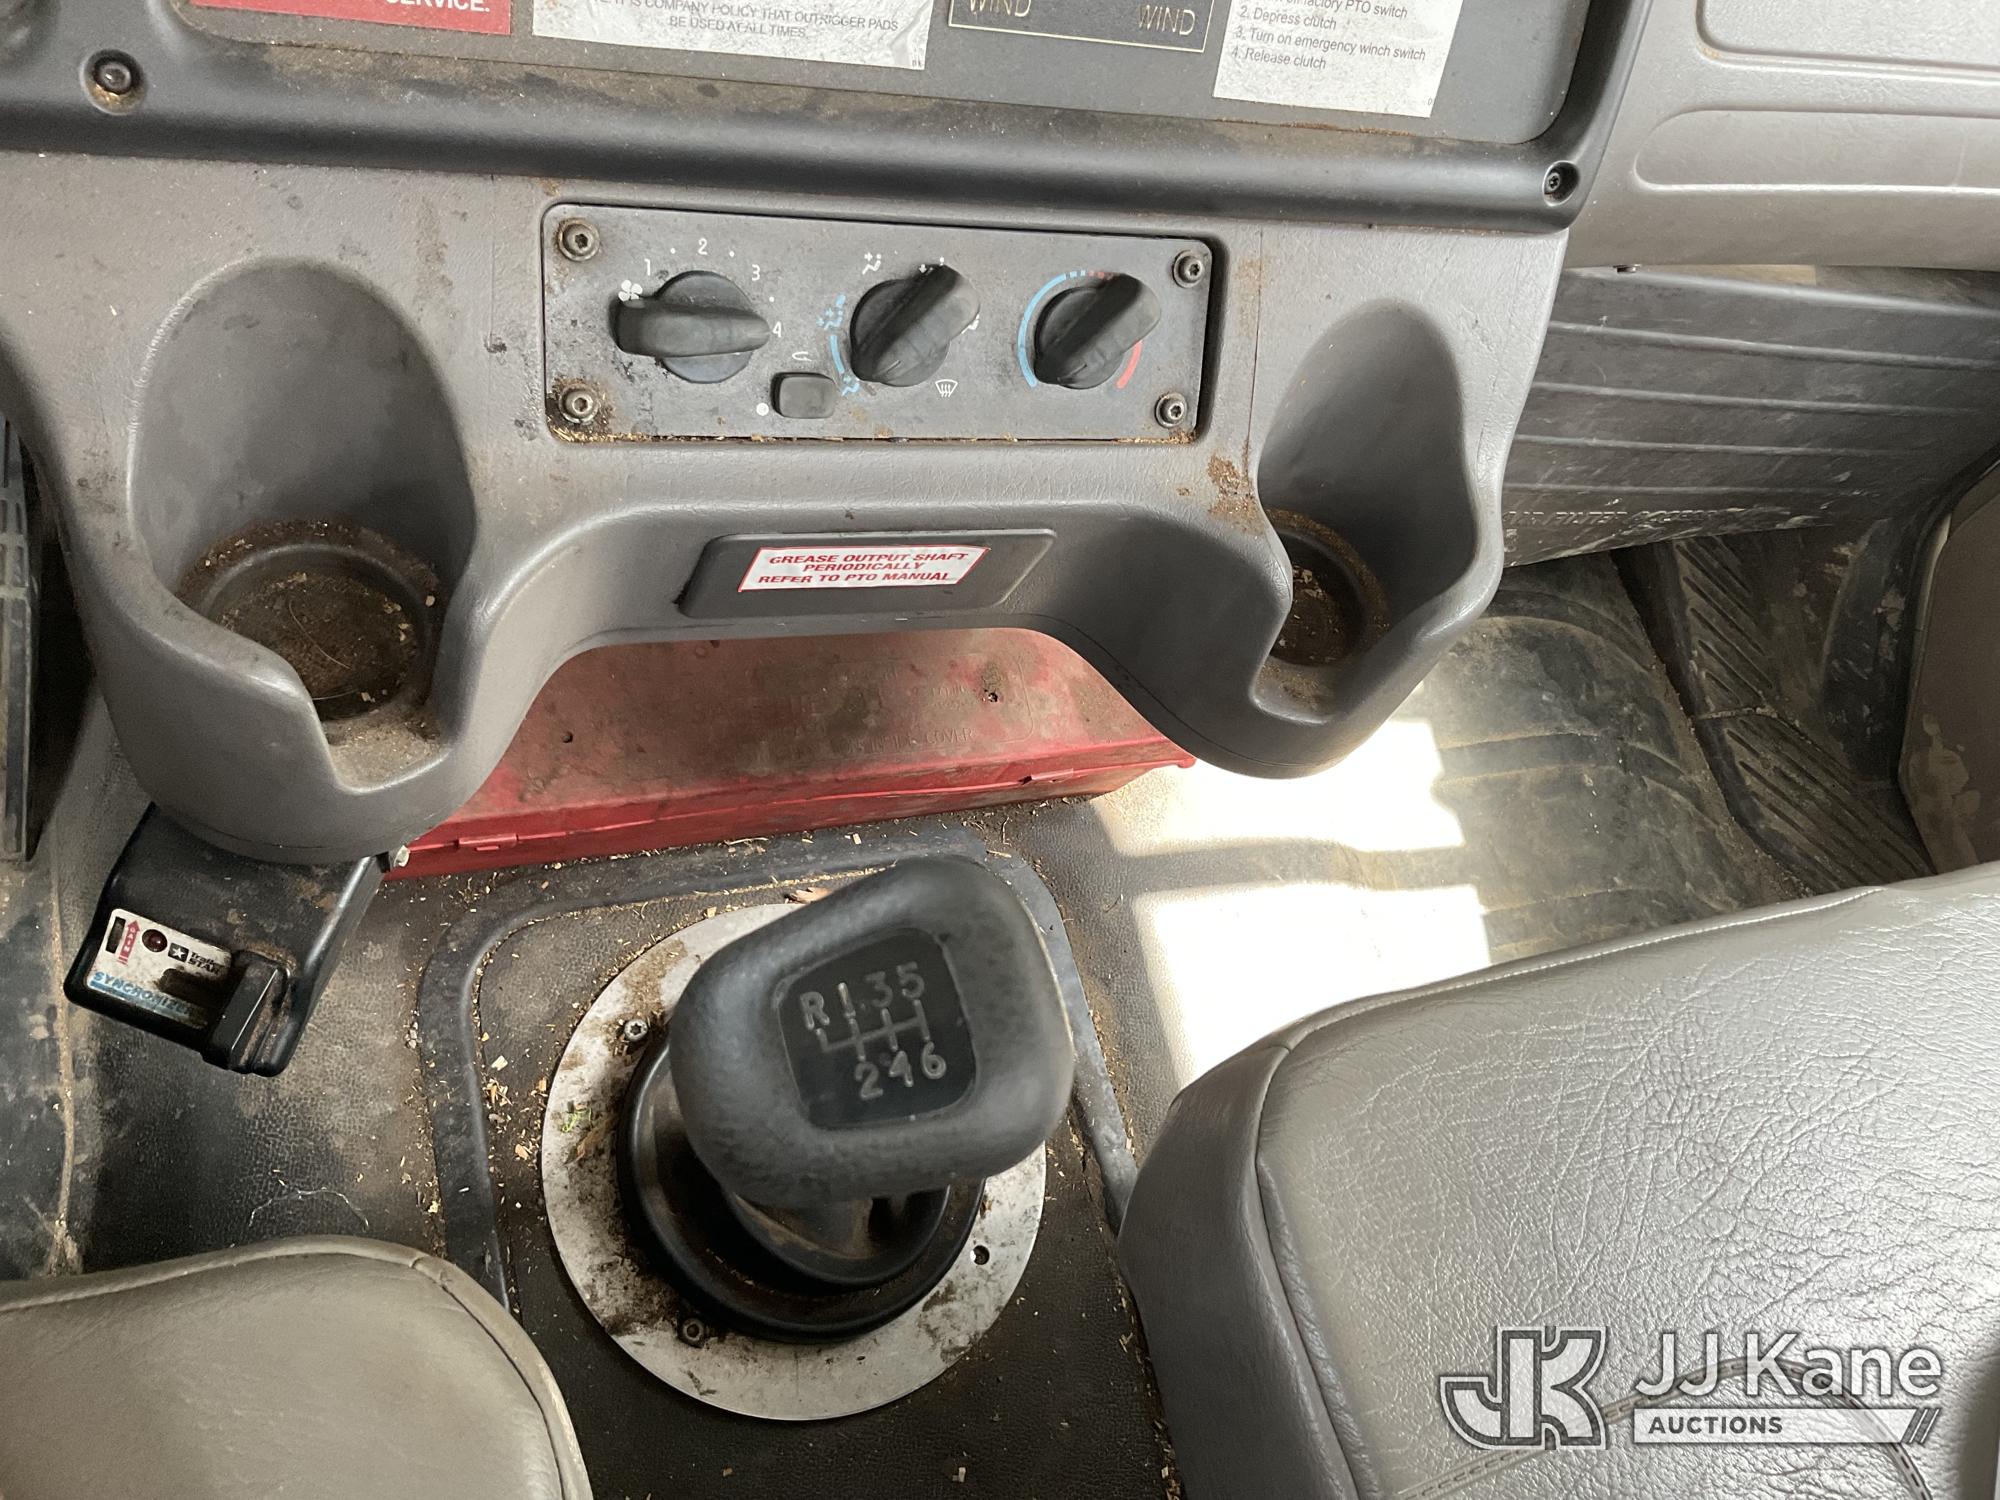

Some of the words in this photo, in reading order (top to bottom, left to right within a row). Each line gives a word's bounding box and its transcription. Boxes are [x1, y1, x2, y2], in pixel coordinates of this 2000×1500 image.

[645, 0, 710, 14] COMPANY
[712, 3, 756, 18] POLICY
[761, 8, 791, 22] THAT
[794, 12, 865, 28] OUTRIGGER
[868, 18, 899, 32] PADS
[1253, 7, 1301, 25] Depress
[1303, 16, 1337, 30] clutch
[1345, 0, 1371, 13] PTO
[1373, 4, 1408, 18] switch
[669, 15, 686, 27] BE
[689, 16, 725, 31] USED
[744, 22, 766, 35] ALL
[770, 24, 806, 38] TIMES
[1138, 4, 1196, 36] WIND
[1250, 27, 1274, 43] Turn
[1277, 34, 1291, 45] on
[1294, 36, 1357, 56] emergency
[1359, 42, 1390, 57] winch
[1393, 47, 1426, 61] switch
[1244, 47, 1290, 65] Release
[1293, 54, 1326, 69] clutch
[697, 237, 708, 256] 2
[643, 258, 651, 277] 1
[751, 264, 761, 282] 3
[772, 321, 782, 339] 4
[769, 553, 837, 565] GREASE
[843, 553, 907, 563] OUTPUT
[912, 552, 969, 562] SHAFT
[802, 562, 925, 572] PERIODICALLY
[757, 574, 812, 584] REFER
[818, 573, 840, 582] TO
[844, 572, 878, 582] PTO
[881, 572, 950, 582] MANUAL
[800, 991, 831, 1031] R
[864, 971, 893, 1008] 3
[896, 961, 925, 999] 5
[854, 1061, 884, 1100] 2
[888, 1050, 914, 1088] 4
[921, 1041, 947, 1080] 6
